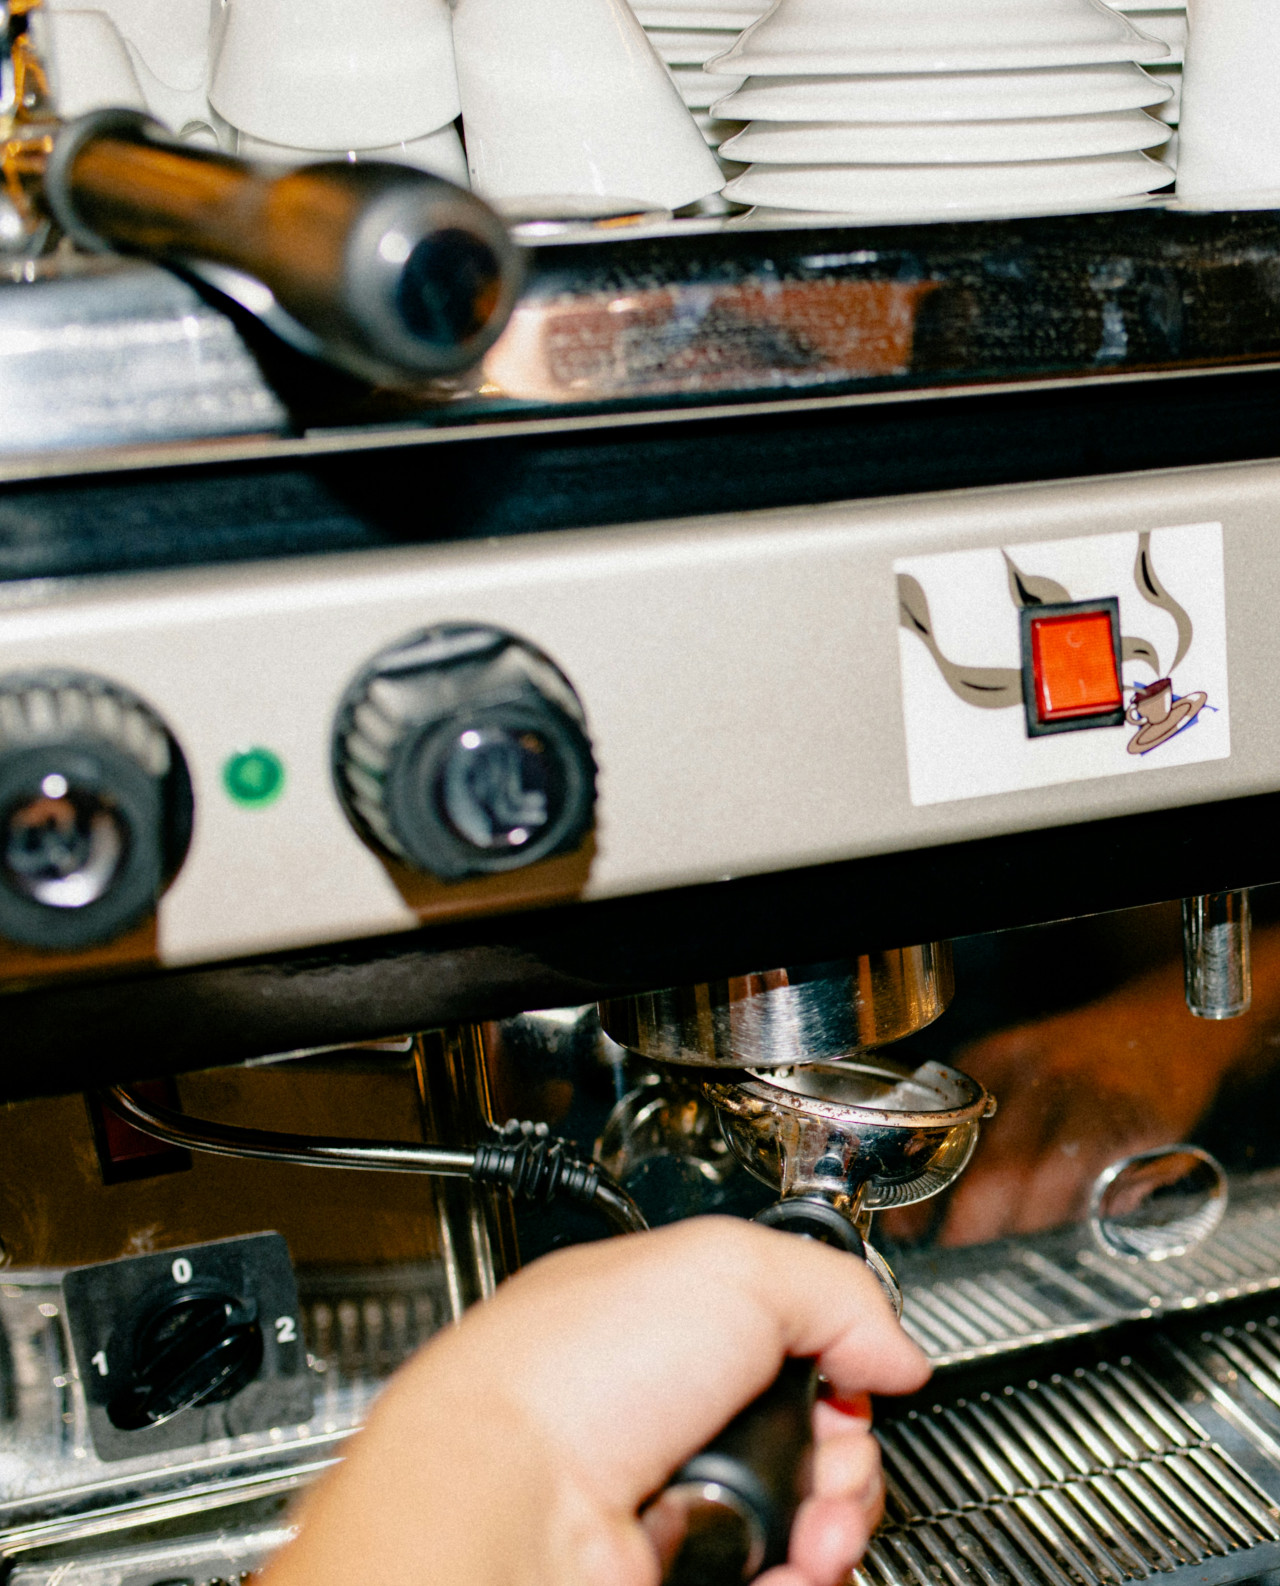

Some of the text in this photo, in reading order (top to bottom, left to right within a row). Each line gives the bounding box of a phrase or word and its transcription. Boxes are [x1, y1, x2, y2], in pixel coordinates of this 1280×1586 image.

[171, 1257, 193, 1284] 0
[274, 1315, 297, 1343] 2
[91, 1350, 109, 1376] 1
